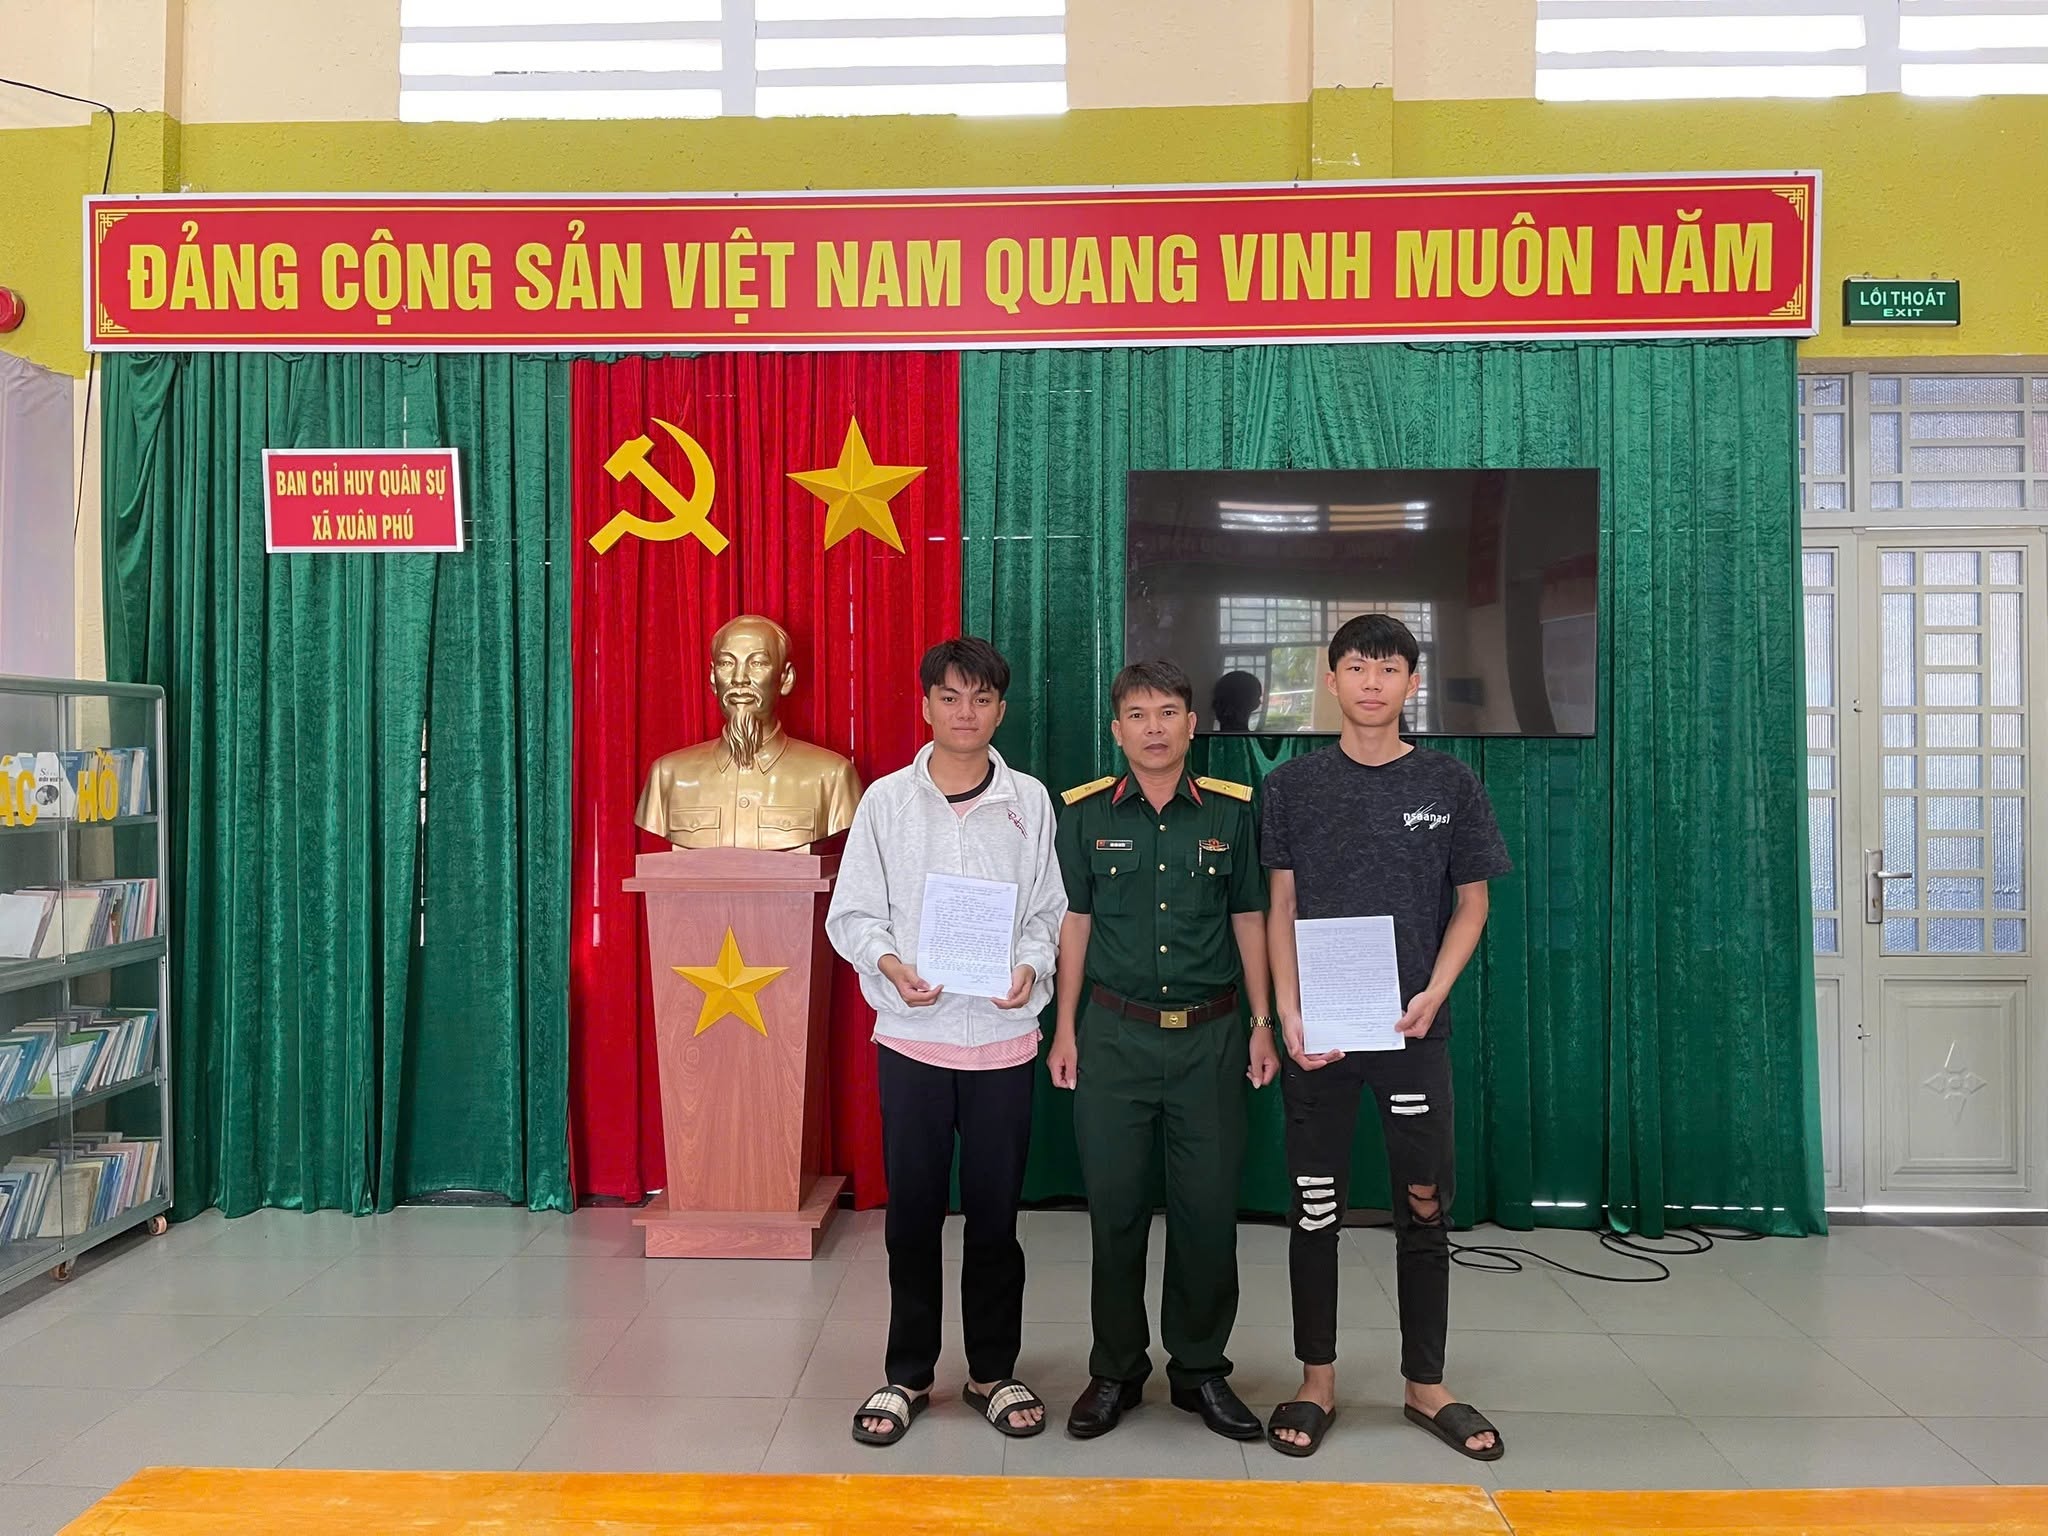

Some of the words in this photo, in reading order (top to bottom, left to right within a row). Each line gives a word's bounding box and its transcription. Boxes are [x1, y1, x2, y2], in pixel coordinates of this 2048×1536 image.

[127, 219, 299, 312] ĐẢNG
[321, 228, 493, 326] CỘNG
[515, 220, 643, 311] SẢN
[663, 227, 796, 326] VIỆT
[816, 240, 962, 309] NAM
[984, 234, 1200, 316] QUANG
[1218, 229, 1373, 303] VINH
[1394, 211, 1594, 300] MUÔN
[1616, 208, 1774, 296] NĂM
[1883, 308, 1924, 317] EXIT
[1890, 288, 1947, 306] THOÁT
[275, 470, 308, 497] BAN
[311, 463, 340, 497] CHỈ
[343, 470, 375, 496] HUY
[379, 464, 421, 498] QUÂN
[425, 466, 447, 501] SỰ
[311, 510, 333, 541] XÃ
[336, 508, 378, 541] XUÂN
[382, 508, 414, 541] PHÚ
